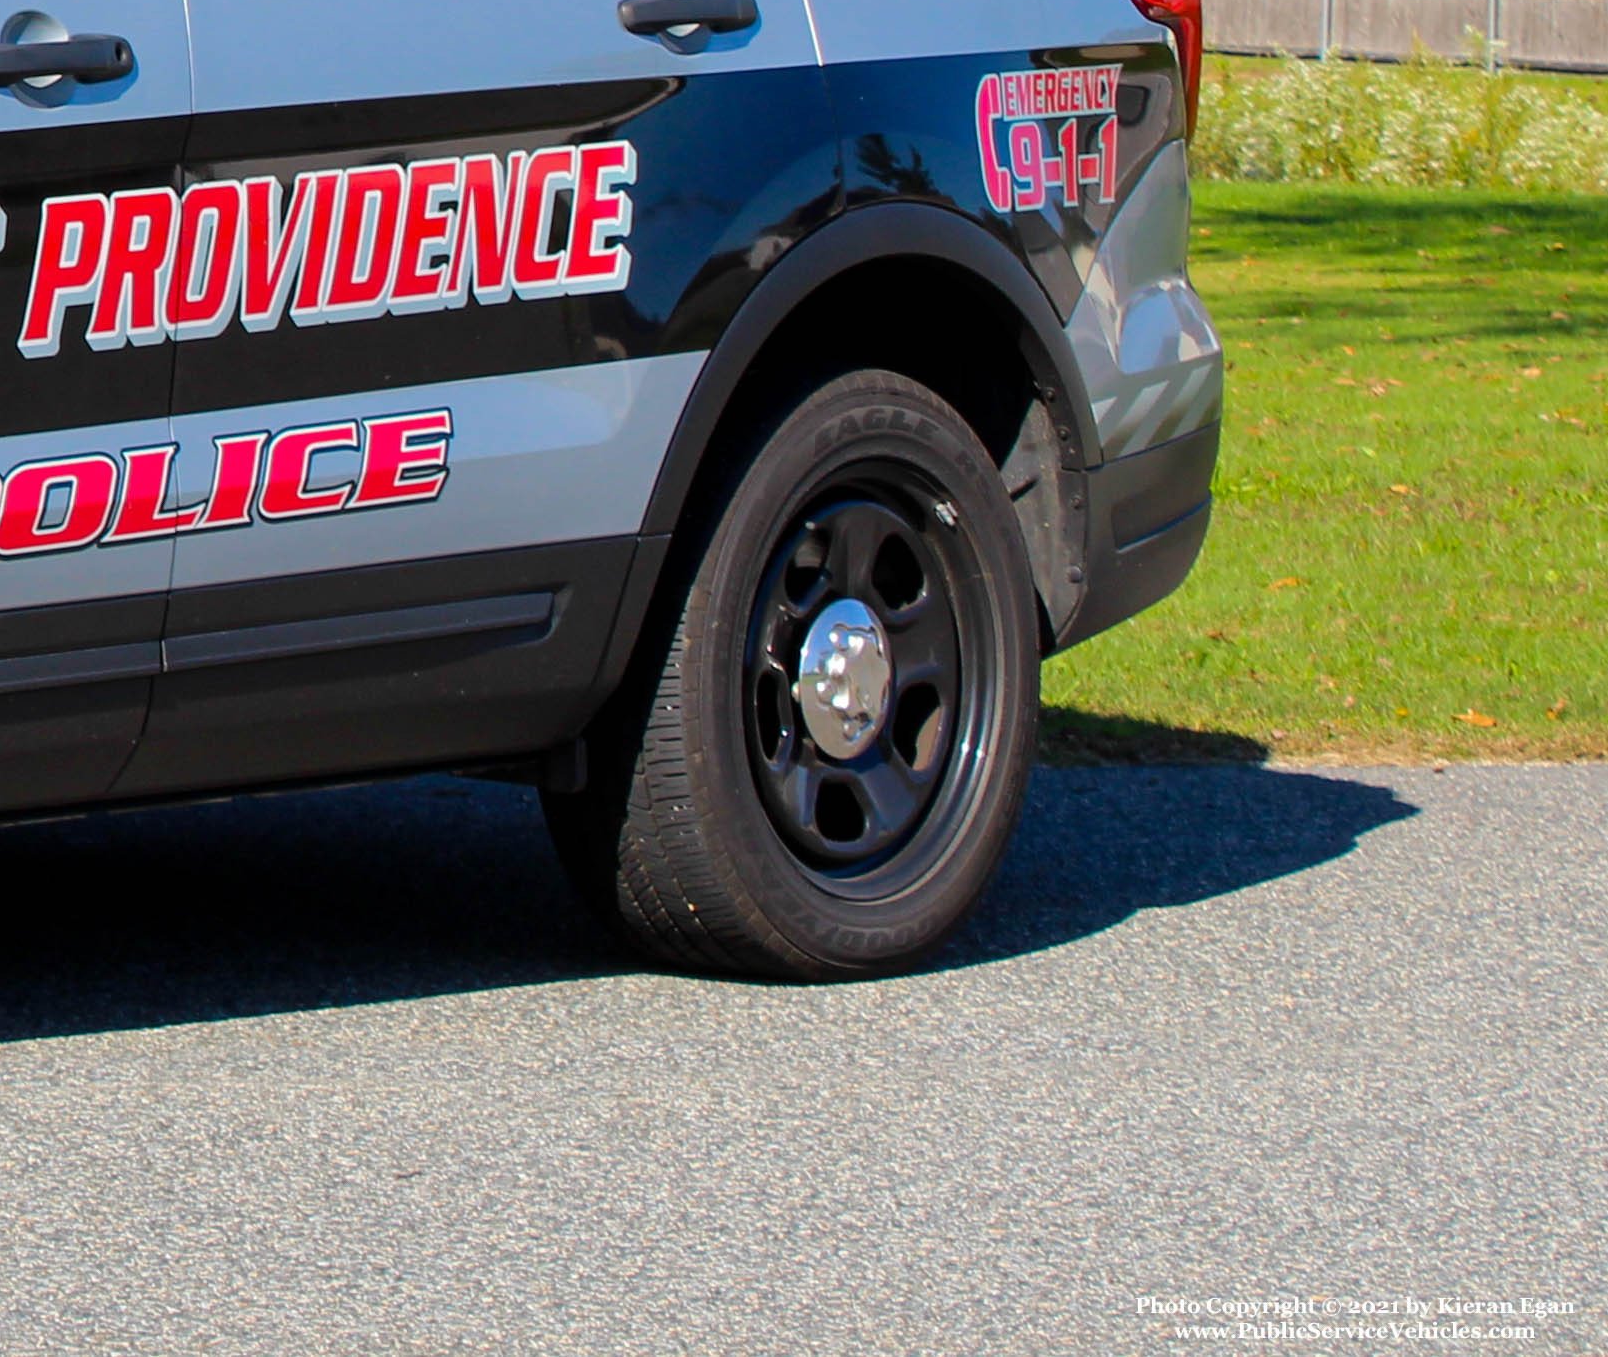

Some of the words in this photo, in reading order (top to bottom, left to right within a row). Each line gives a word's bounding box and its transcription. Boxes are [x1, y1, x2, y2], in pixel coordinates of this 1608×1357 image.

[1001, 64, 1122, 121] EMERGENCY
[1009, 115, 1118, 212] 9-1-1
[17, 139, 637, 358] PROVIDENCE
